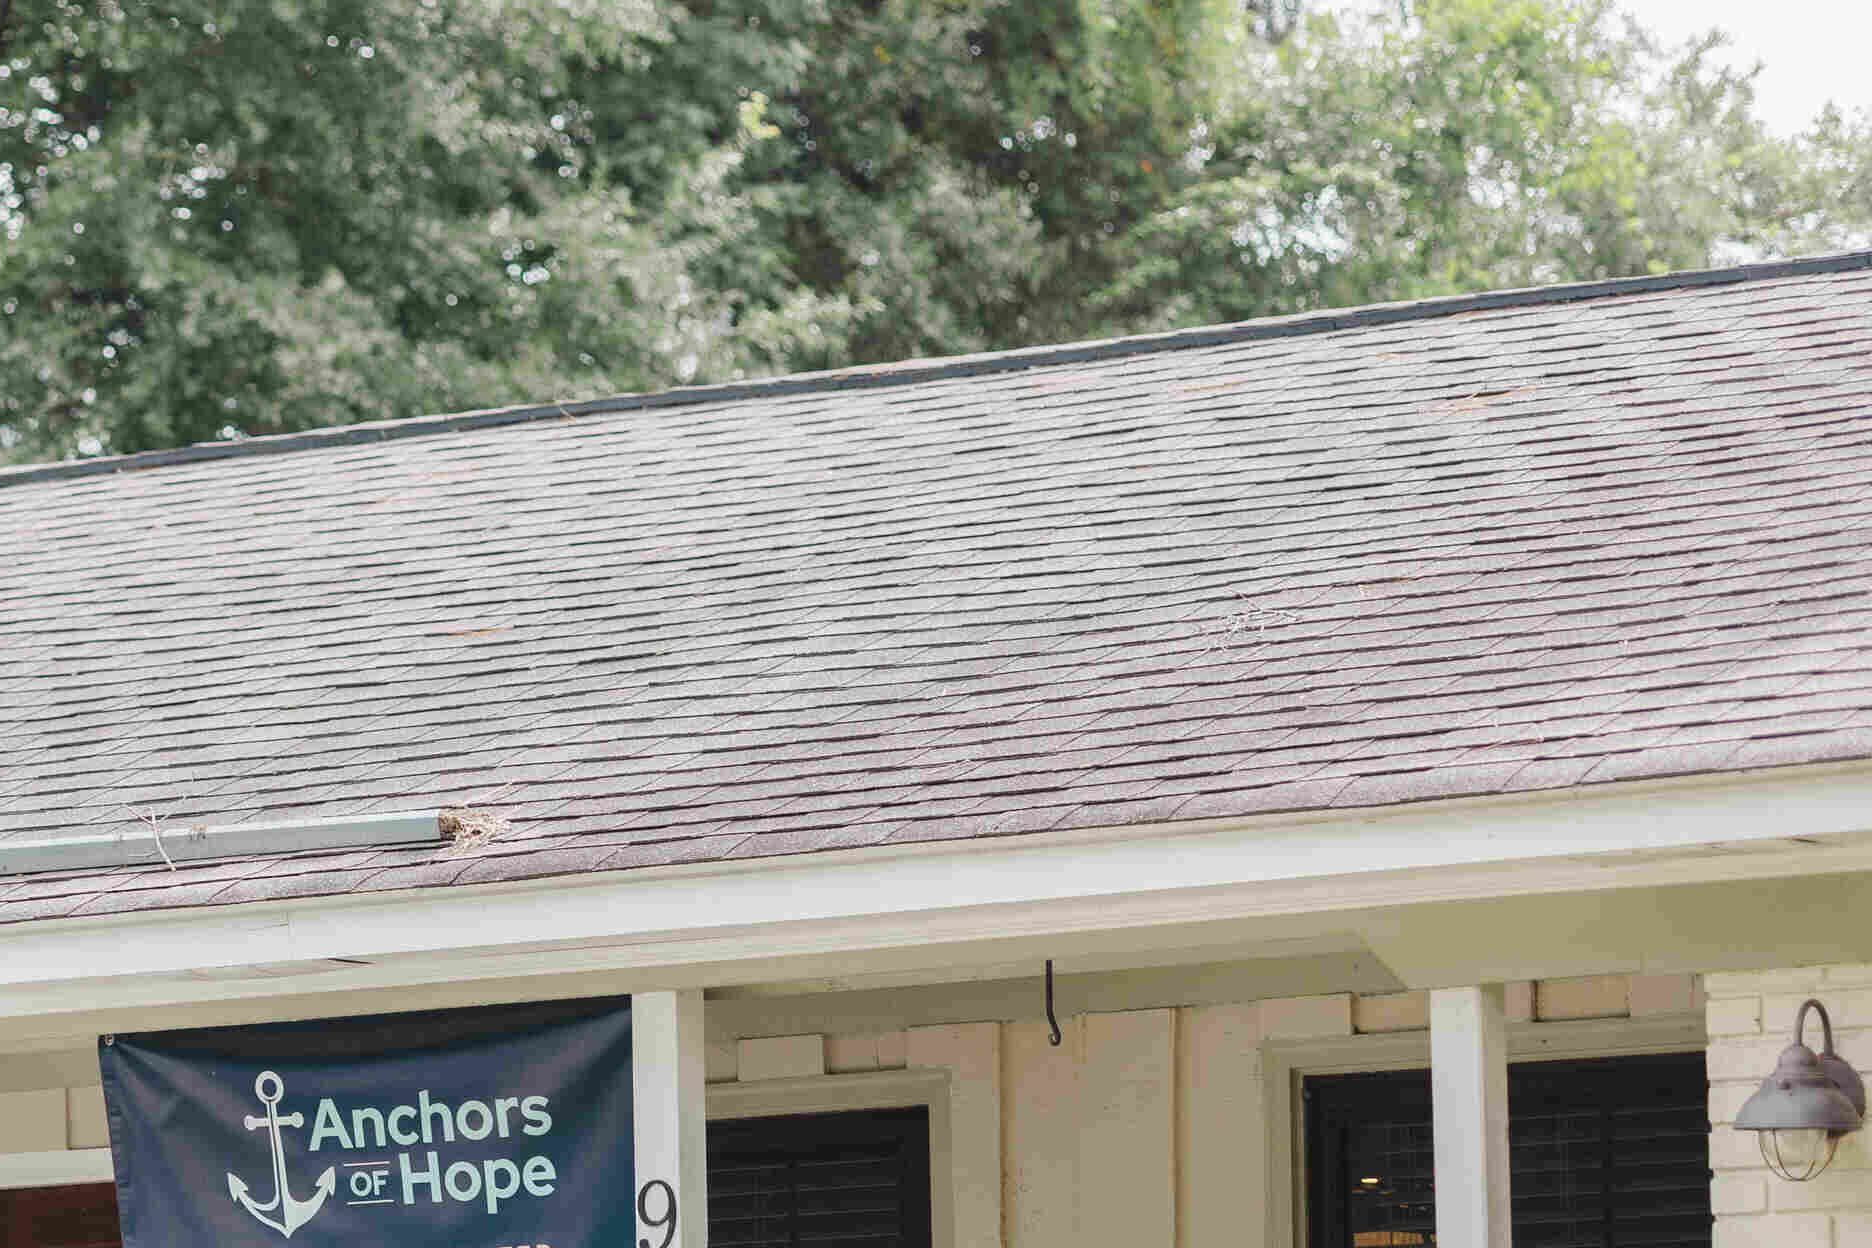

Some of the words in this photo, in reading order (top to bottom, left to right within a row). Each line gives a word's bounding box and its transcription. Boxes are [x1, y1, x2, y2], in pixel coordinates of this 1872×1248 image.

[308, 1089, 553, 1152] Anchors
[349, 1168, 389, 1197] OF
[399, 1151, 557, 1214] Hope
